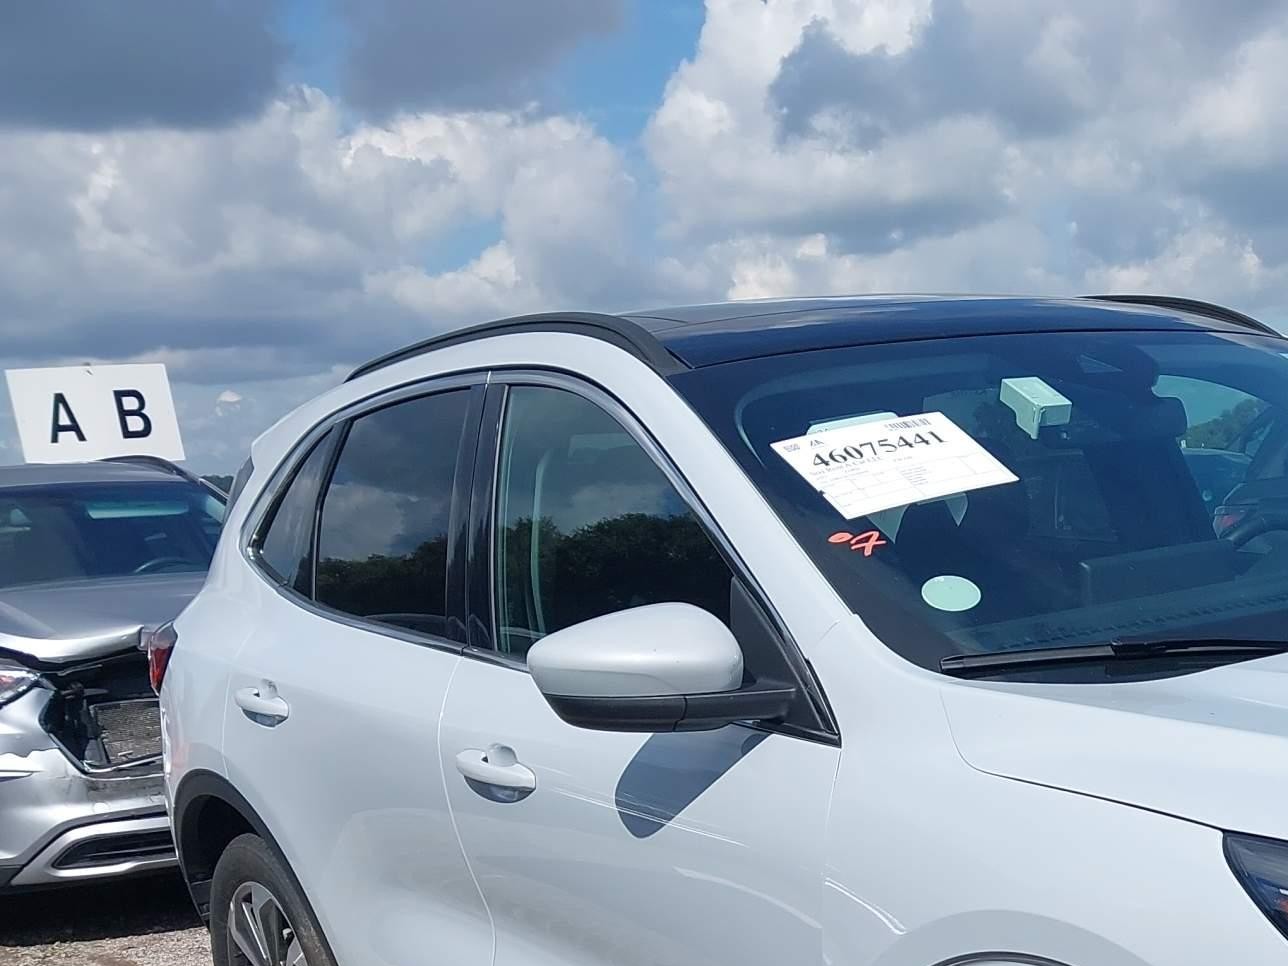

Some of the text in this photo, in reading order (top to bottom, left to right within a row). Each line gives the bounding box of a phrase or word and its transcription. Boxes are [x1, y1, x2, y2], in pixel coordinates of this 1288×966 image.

[50, 389, 153, 444] A B
[811, 430, 948, 468] 46075441
